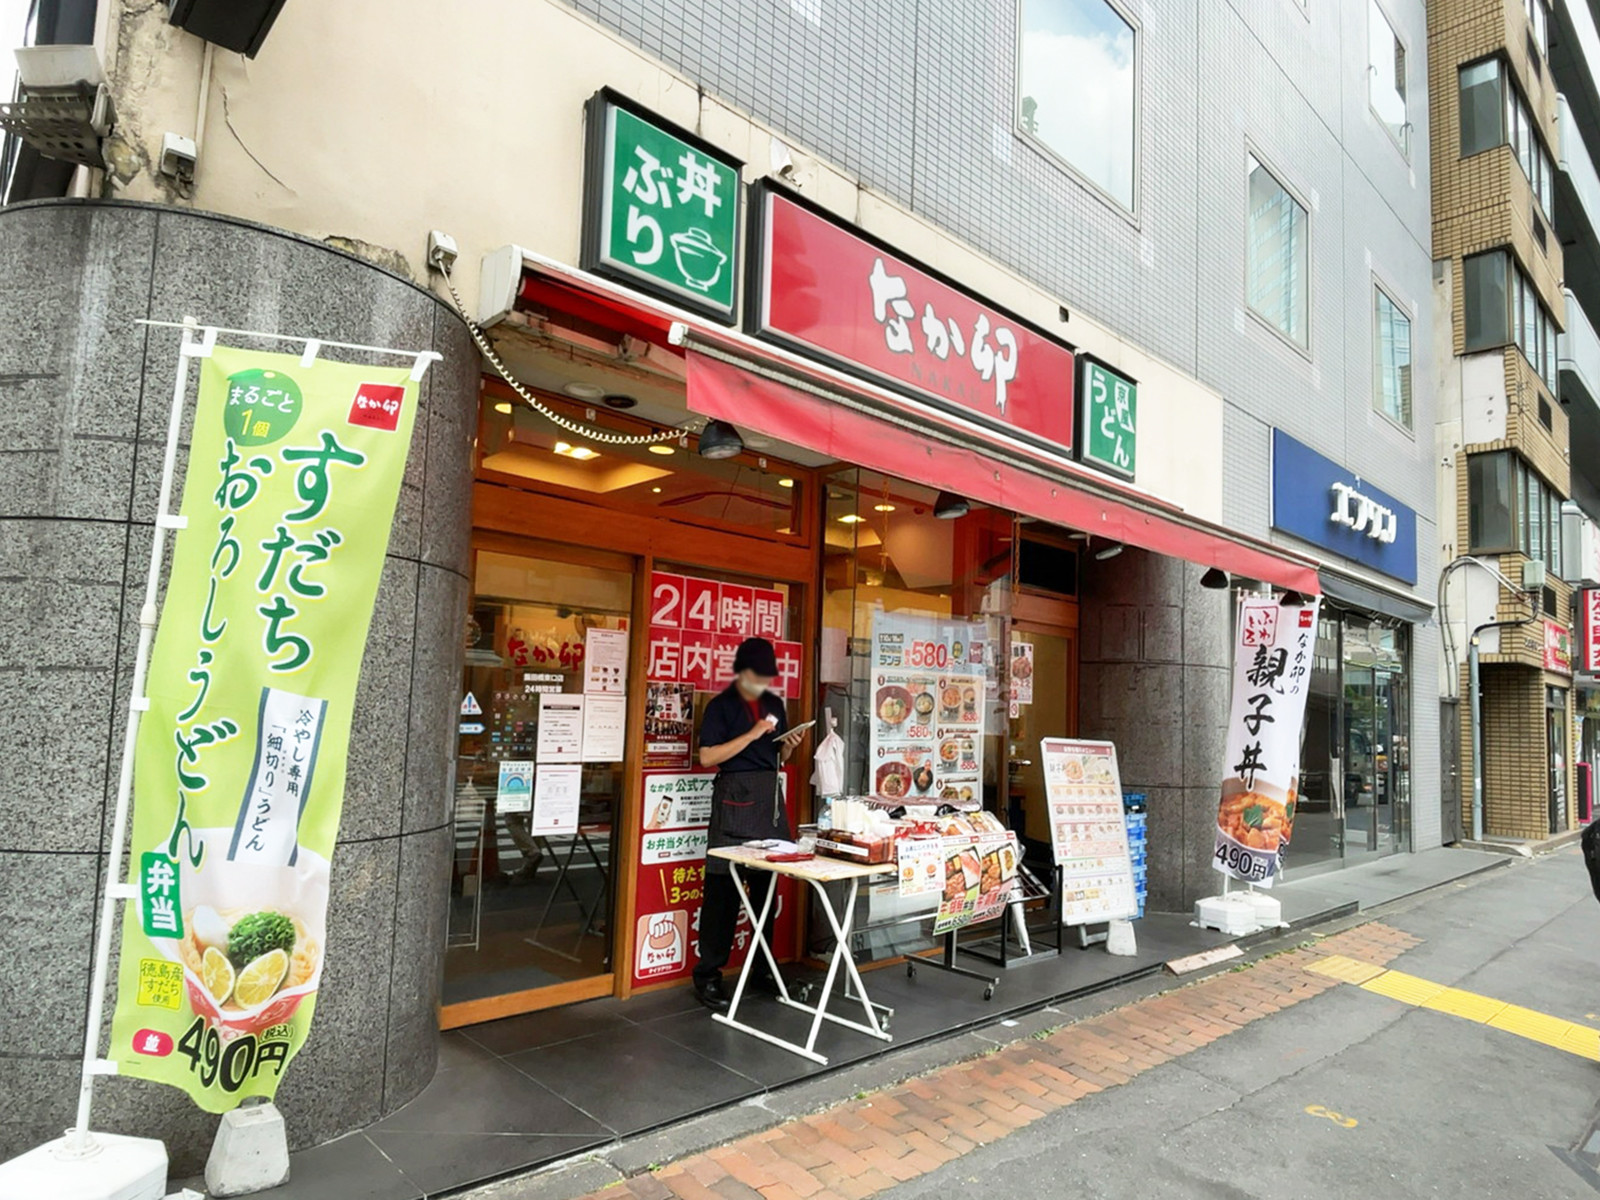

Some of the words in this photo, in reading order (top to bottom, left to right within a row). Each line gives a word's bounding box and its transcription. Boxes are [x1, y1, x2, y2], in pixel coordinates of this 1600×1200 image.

[868, 256, 1018, 414] なか卯
[228, 386, 295, 413] まるごと
[241, 409, 271, 438] 1個
[356, 394, 400, 416] なか卯
[1092, 370, 1130, 468] うどん
[258, 431, 365, 671] すだち
[651, 583, 783, 637] 24時間
[168, 439, 273, 867] おろしうどん
[507, 636, 584, 671] なか卯
[647, 636, 799, 698] 店内営中
[1289, 632, 1308, 694] なか卯の
[1233, 644, 1289, 790] 親子丼
[285, 709, 314, 798] 冷やし専用
[245, 723, 287, 852] 「細切り」うどん
[675, 778, 714, 793] 公式ア
[1215, 843, 1267, 880] 490円
[146, 859, 177, 932] 弁当
[140, 962, 183, 982] 徳島産
[143, 978, 179, 996] すだち
[143, 1034, 160, 1052] 並
[176, 1017, 289, 1092] 490円
